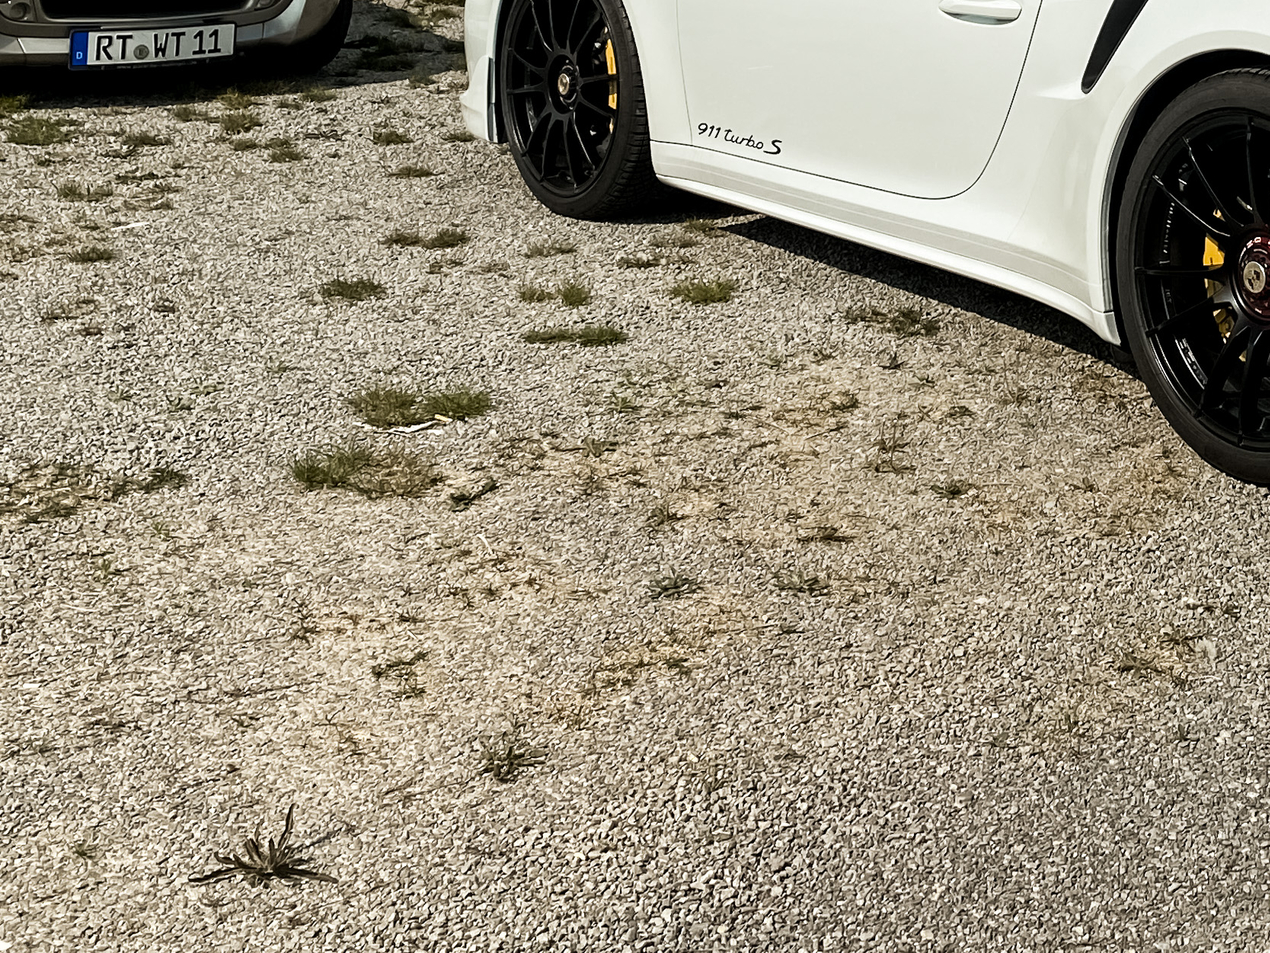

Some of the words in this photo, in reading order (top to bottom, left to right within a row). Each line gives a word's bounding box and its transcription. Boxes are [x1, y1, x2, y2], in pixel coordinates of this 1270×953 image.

[75, 51, 83, 60] D
[95, 34, 133, 61] RT
[153, 31, 186, 58] WT
[192, 28, 222, 55] 11
[697, 122, 721, 139] 911
[763, 139, 783, 155] S
